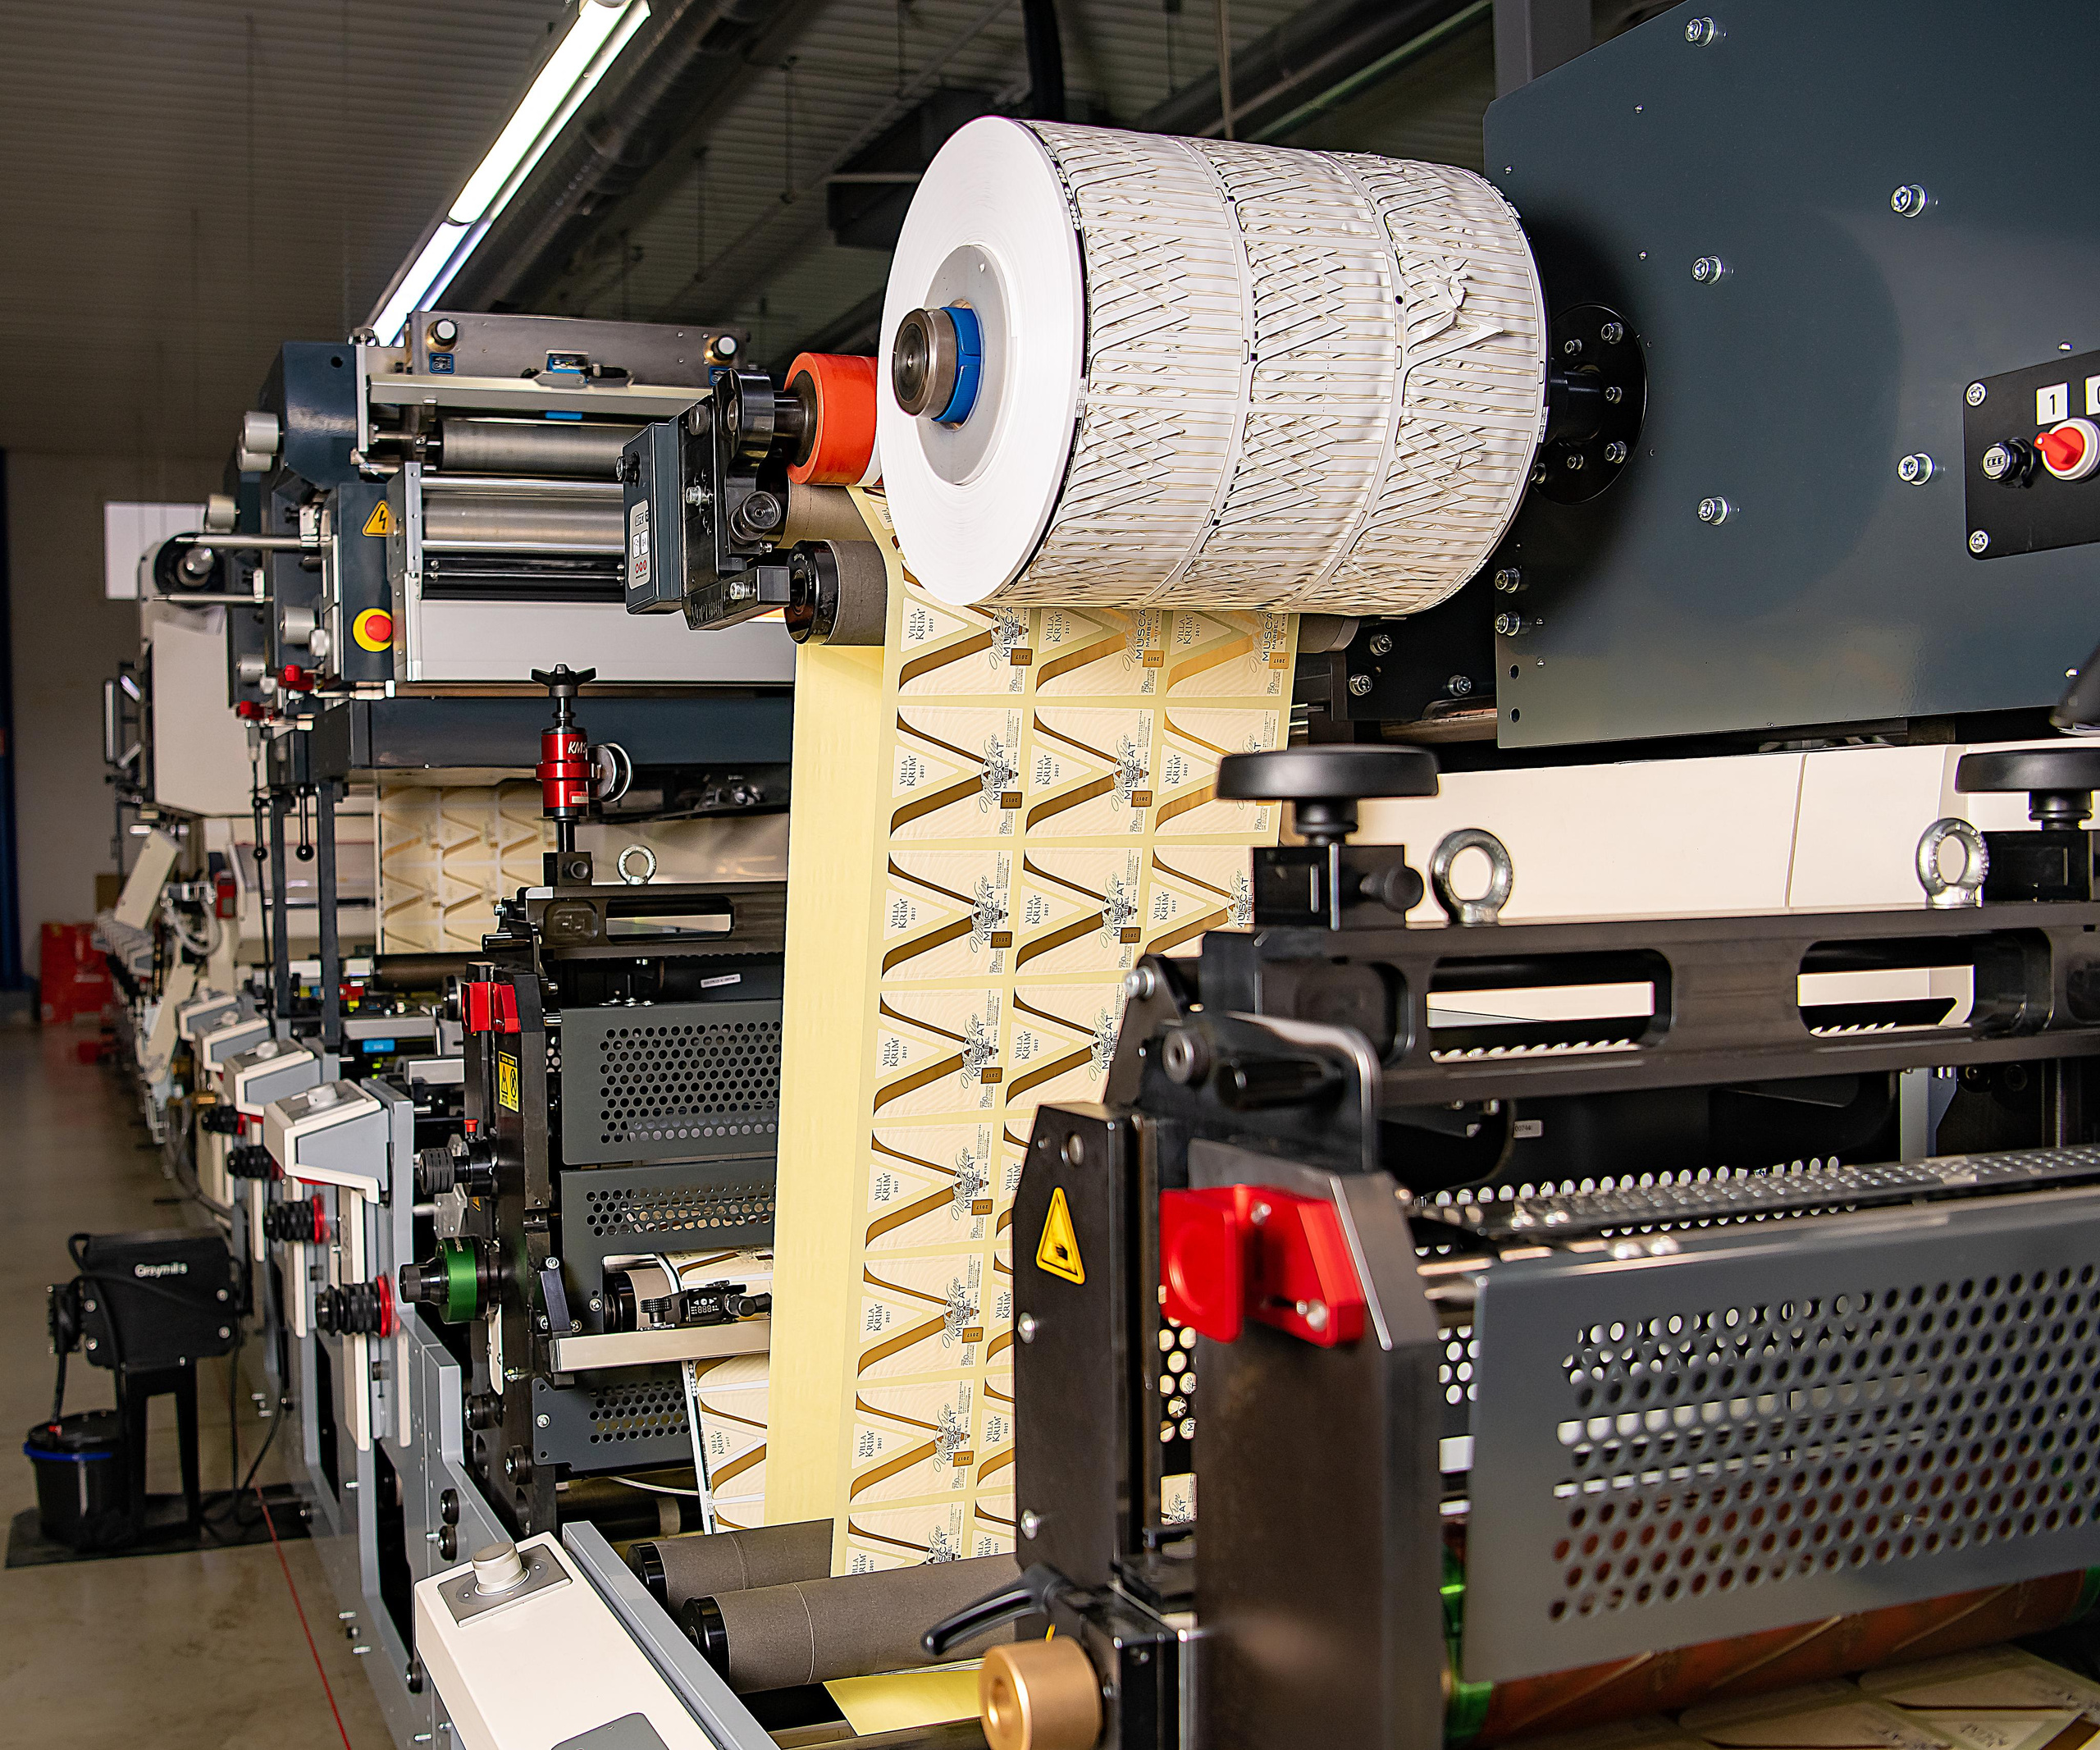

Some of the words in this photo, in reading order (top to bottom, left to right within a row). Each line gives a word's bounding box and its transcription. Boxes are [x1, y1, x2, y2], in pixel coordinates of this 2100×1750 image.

[2049, 394, 2056, 415] 1
[909, 613, 917, 638] VILLA
[1002, 607, 1013, 657] MUSCA
[1046, 615, 1054, 640] VILLA
[1135, 610, 1146, 659] MUSCA
[1262, 613, 1273, 660] MUSCA
[900, 760, 908, 784] VILLA
[993, 742, 1004, 801] MUSCAT
[1125, 742, 1136, 799] MUSCAT
[1165, 759, 1173, 783] VILLA
[984, 884, 994, 940] MUSCAT
[1025, 900, 1034, 923] VILLA
[1113, 880, 1124, 936] MUSCAT
[883, 1042, 891, 1066] VILLA
[974, 1021, 984, 1076] MUSCAT
[1015, 1035, 1023, 1058] VILLA
[1102, 1016, 1113, 1069] MUSCAT
[874, 1177, 883, 1200] VILLA
[965, 1155, 975, 1209] MUSCAT
[1012, 1165, 1021, 1191] KRIM
[866, 1309, 874, 1331] VILLA
[956, 1285, 966, 1336] MUSCAT
[947, 1410, 956, 1460] MUSCAT
[938, 1532, 947, 1562] SCAT
